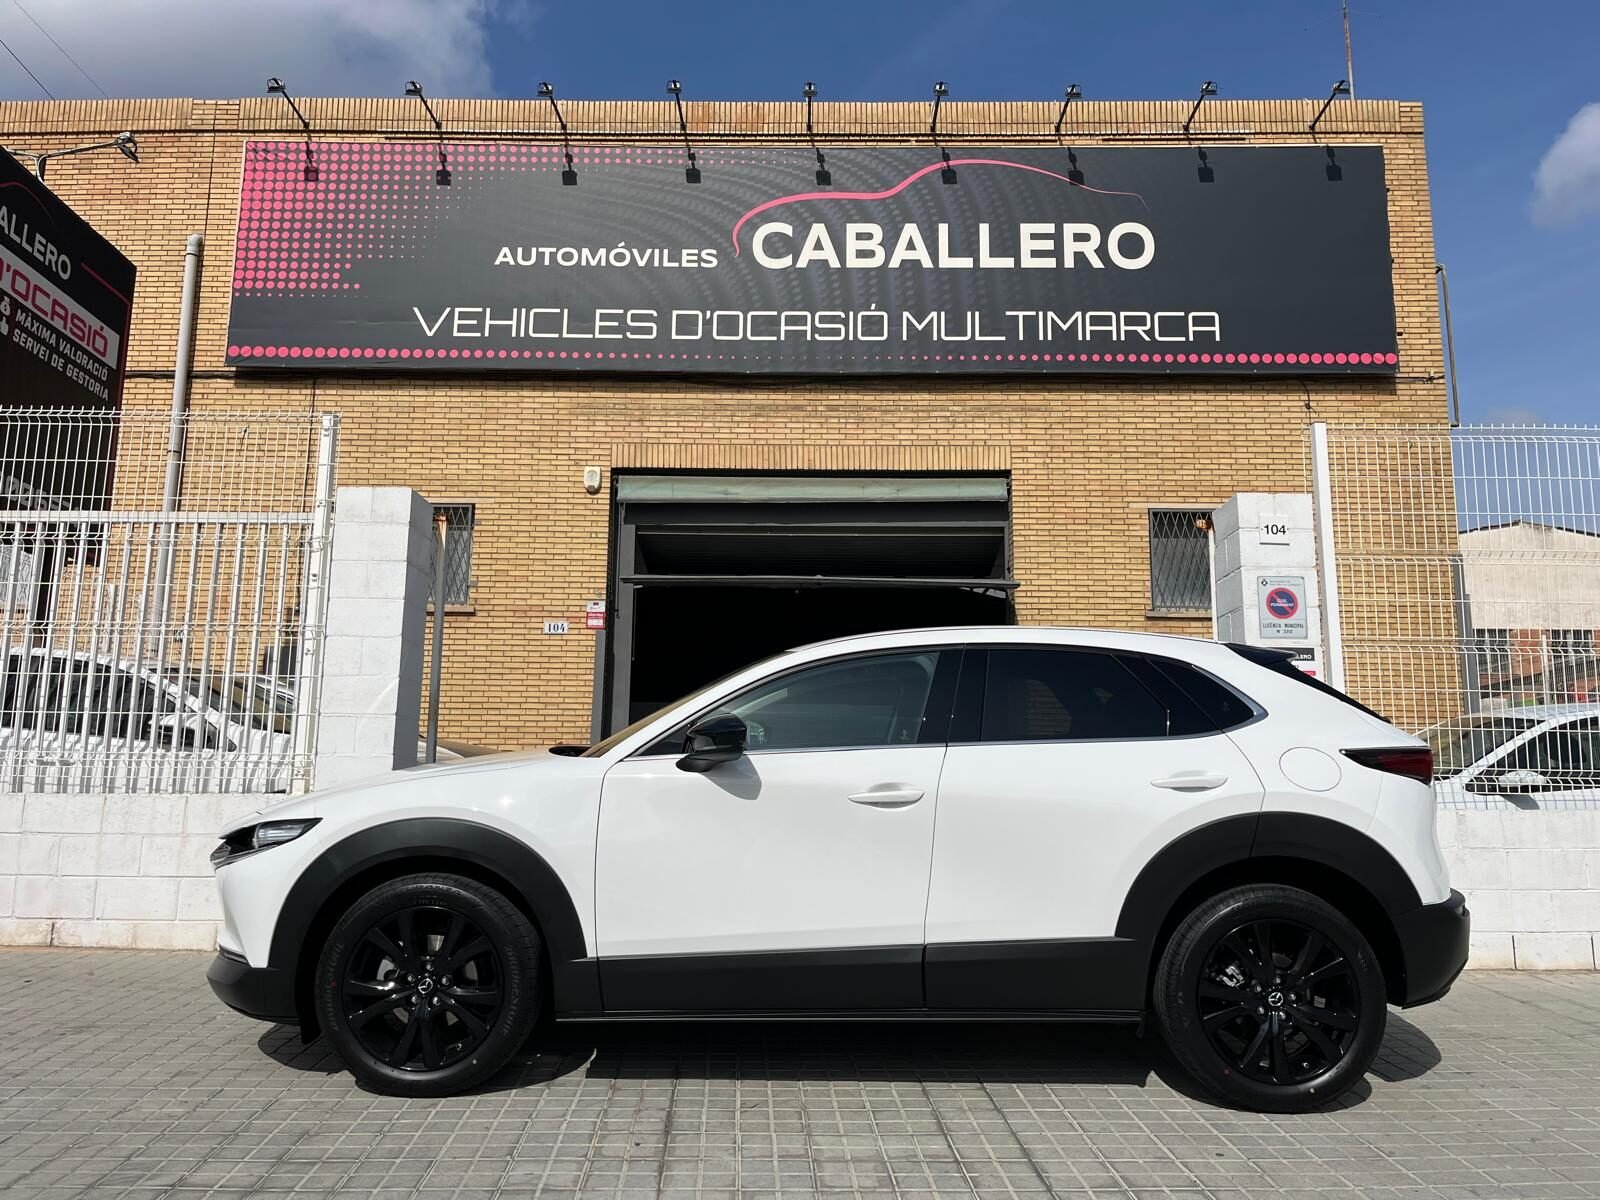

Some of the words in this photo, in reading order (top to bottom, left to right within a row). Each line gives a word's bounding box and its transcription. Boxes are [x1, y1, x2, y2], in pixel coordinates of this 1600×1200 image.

[494, 242, 719, 269] AUTOMÓVILES
[751, 221, 1156, 271] CABALLERO
[16, 307, 56, 348] MÀXIMA
[59, 338, 108, 381] VALORACIÓ
[413, 307, 657, 340] VEHICLES
[671, 302, 888, 342] D'OCASIÓ
[902, 308, 1221, 343] MULTIMARCA
[12, 330, 49, 362] SERVEI
[51, 353, 65, 372] DE
[66, 363, 109, 401] GESTORIA
[1264, 524, 1287, 535] 104
[548, 623, 565, 633] 104
